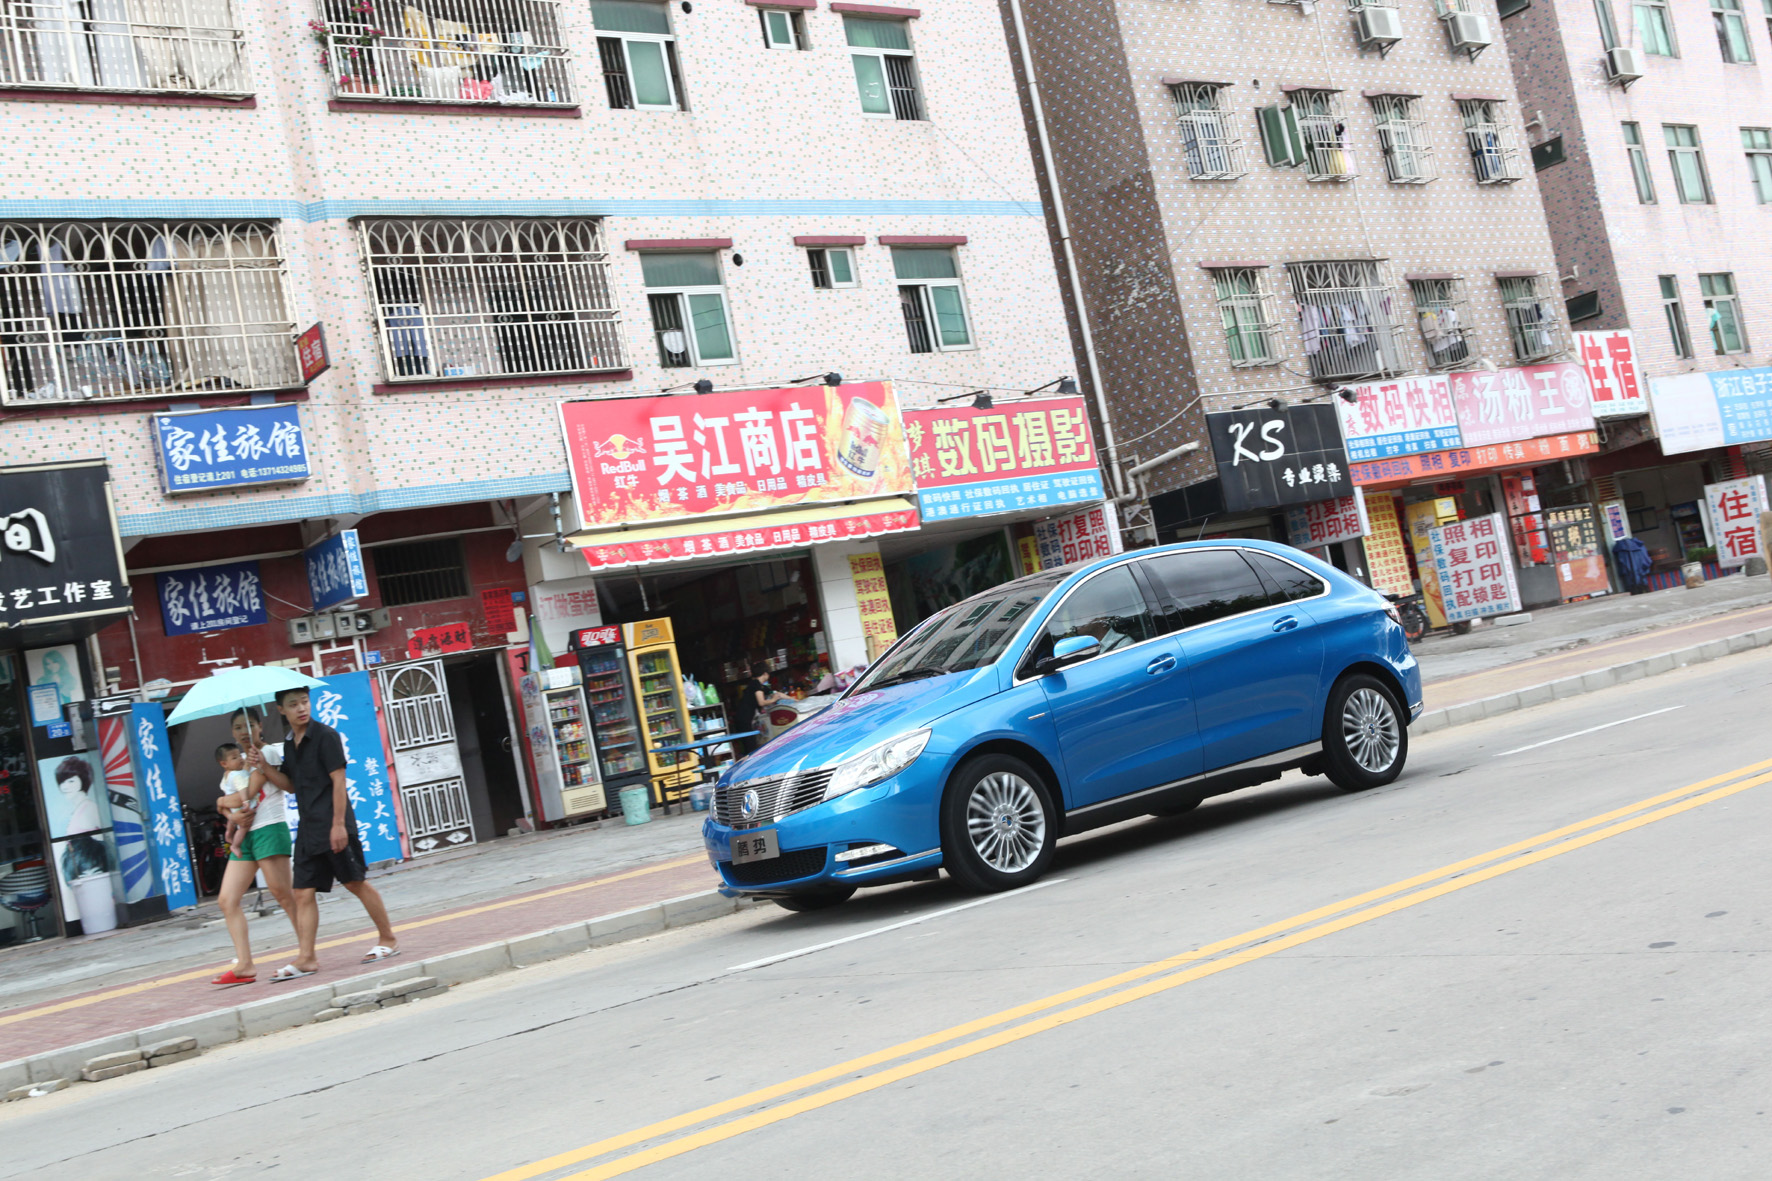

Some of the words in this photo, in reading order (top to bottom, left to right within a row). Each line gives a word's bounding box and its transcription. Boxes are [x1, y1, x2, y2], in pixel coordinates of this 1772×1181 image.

[1579, 332, 1640, 402] 住宿
[1356, 380, 1454, 434] 数码快相
[1472, 370, 1566, 424] 汤粉王
[165, 421, 301, 471] 家佳旅馆
[649, 402, 822, 486] 吴江商店
[906, 420, 936, 480] 梦琪
[932, 407, 1092, 478] 数码摄影
[1228, 419, 1285, 466] KS
[1351, 459, 1413, 482] 社保数码回执
[1420, 453, 1444, 472] 照相
[1449, 450, 1472, 469] 复印
[1502, 442, 1525, 461] 传真
[600, 459, 646, 476] RedBull
[614, 475, 640, 489] 红牛
[676, 486, 690, 501] 茶
[695, 484, 708, 499] 酒
[757, 477, 788, 493] 日用品
[964, 482, 1020, 499] 社保数码回执
[1022, 479, 1050, 493] 居住证
[1052, 474, 1097, 489] 驾驶证回执
[1281, 462, 1342, 487] 专业烫染
[925, 500, 1006, 518] 港澳通行证回执
[1443, 518, 1494, 546] 照相
[1718, 490, 1758, 557] 住宿
[701, 538, 713, 551] 茶
[718, 536, 730, 549] 酒
[773, 528, 801, 543] 日用品
[1448, 540, 1498, 568] 复印
[309, 547, 349, 602] 家佳旅馆
[1431, 531, 1456, 611] 社保数码回执
[1452, 562, 1502, 589] 打印
[1455, 582, 1507, 608] 配锁匙
[164, 570, 261, 626] 家佳旅馆
[138, 717, 182, 896] 家佳旅馆
[364, 757, 395, 841] 整洁大气
